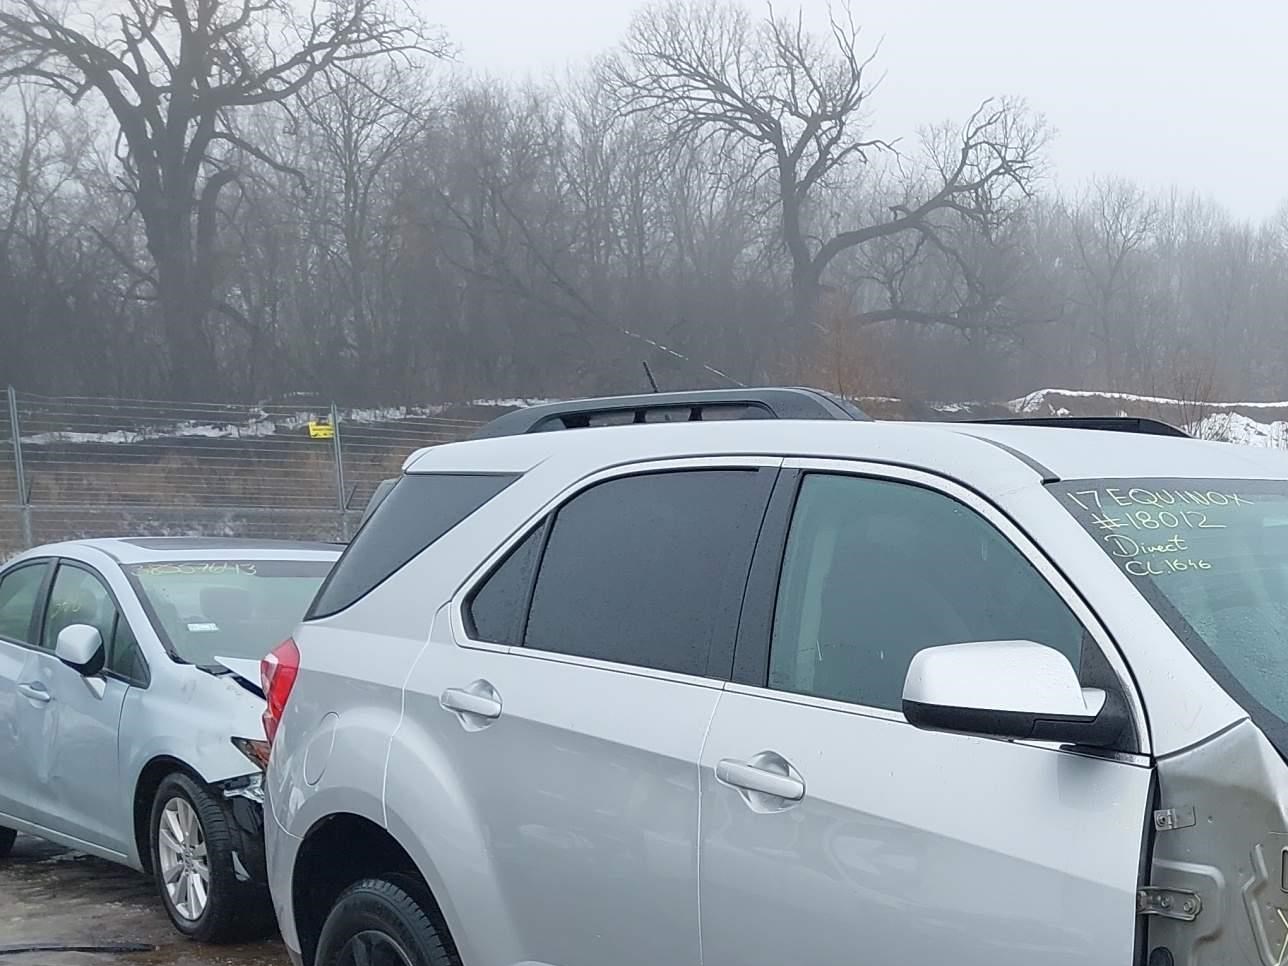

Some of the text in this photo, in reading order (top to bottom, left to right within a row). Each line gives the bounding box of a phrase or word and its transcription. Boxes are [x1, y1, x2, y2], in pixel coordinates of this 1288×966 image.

[1066, 488, 1254, 510] 17 EQUINOX
[1091, 511, 1227, 530] #18012
